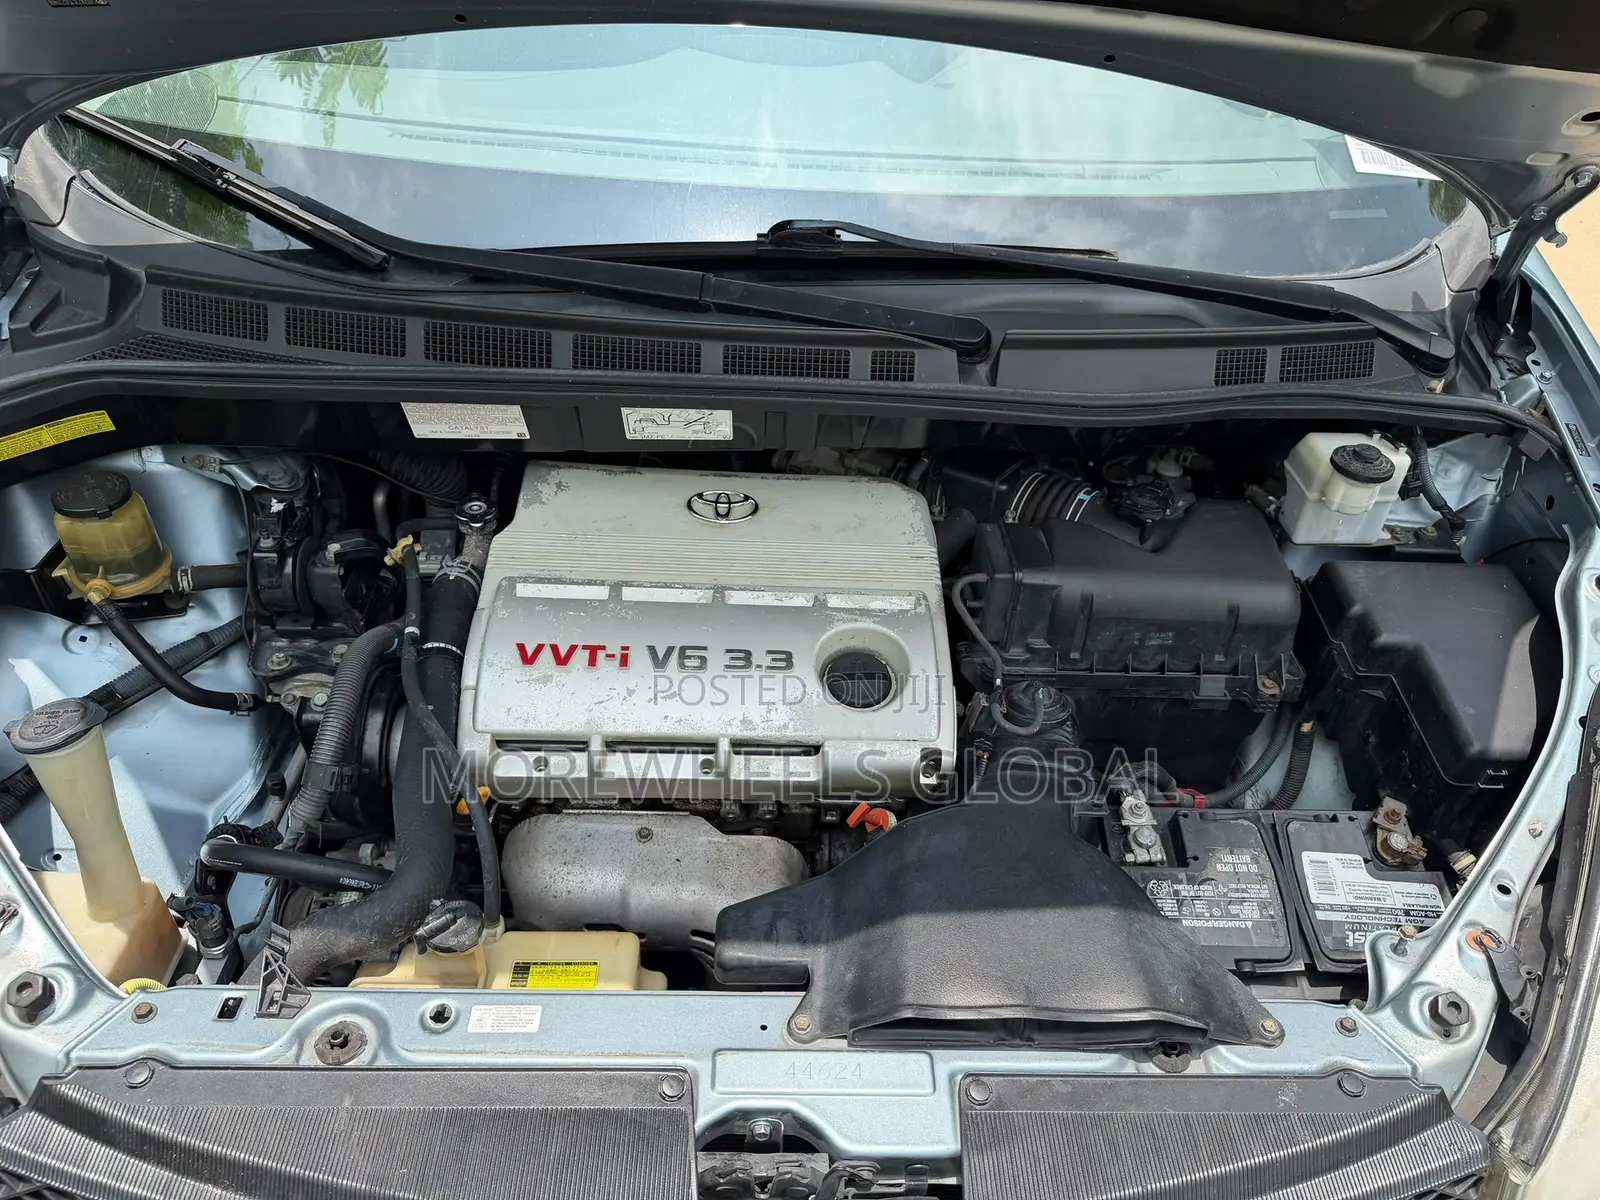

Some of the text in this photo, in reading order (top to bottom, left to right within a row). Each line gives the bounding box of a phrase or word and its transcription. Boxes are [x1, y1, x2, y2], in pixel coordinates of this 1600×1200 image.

[516, 642, 794, 674] VVT-i V6 3.3
[1220, 854, 1251, 863] BATTERY!
[1216, 863, 1233, 871] OPEN
[1235, 864, 1247, 872] NOT
[1344, 914, 1402, 923] TECHNOLOGY
[1182, 919, 1245, 928] DANGER/POISON
[785, 1062, 864, 1080] 44624
